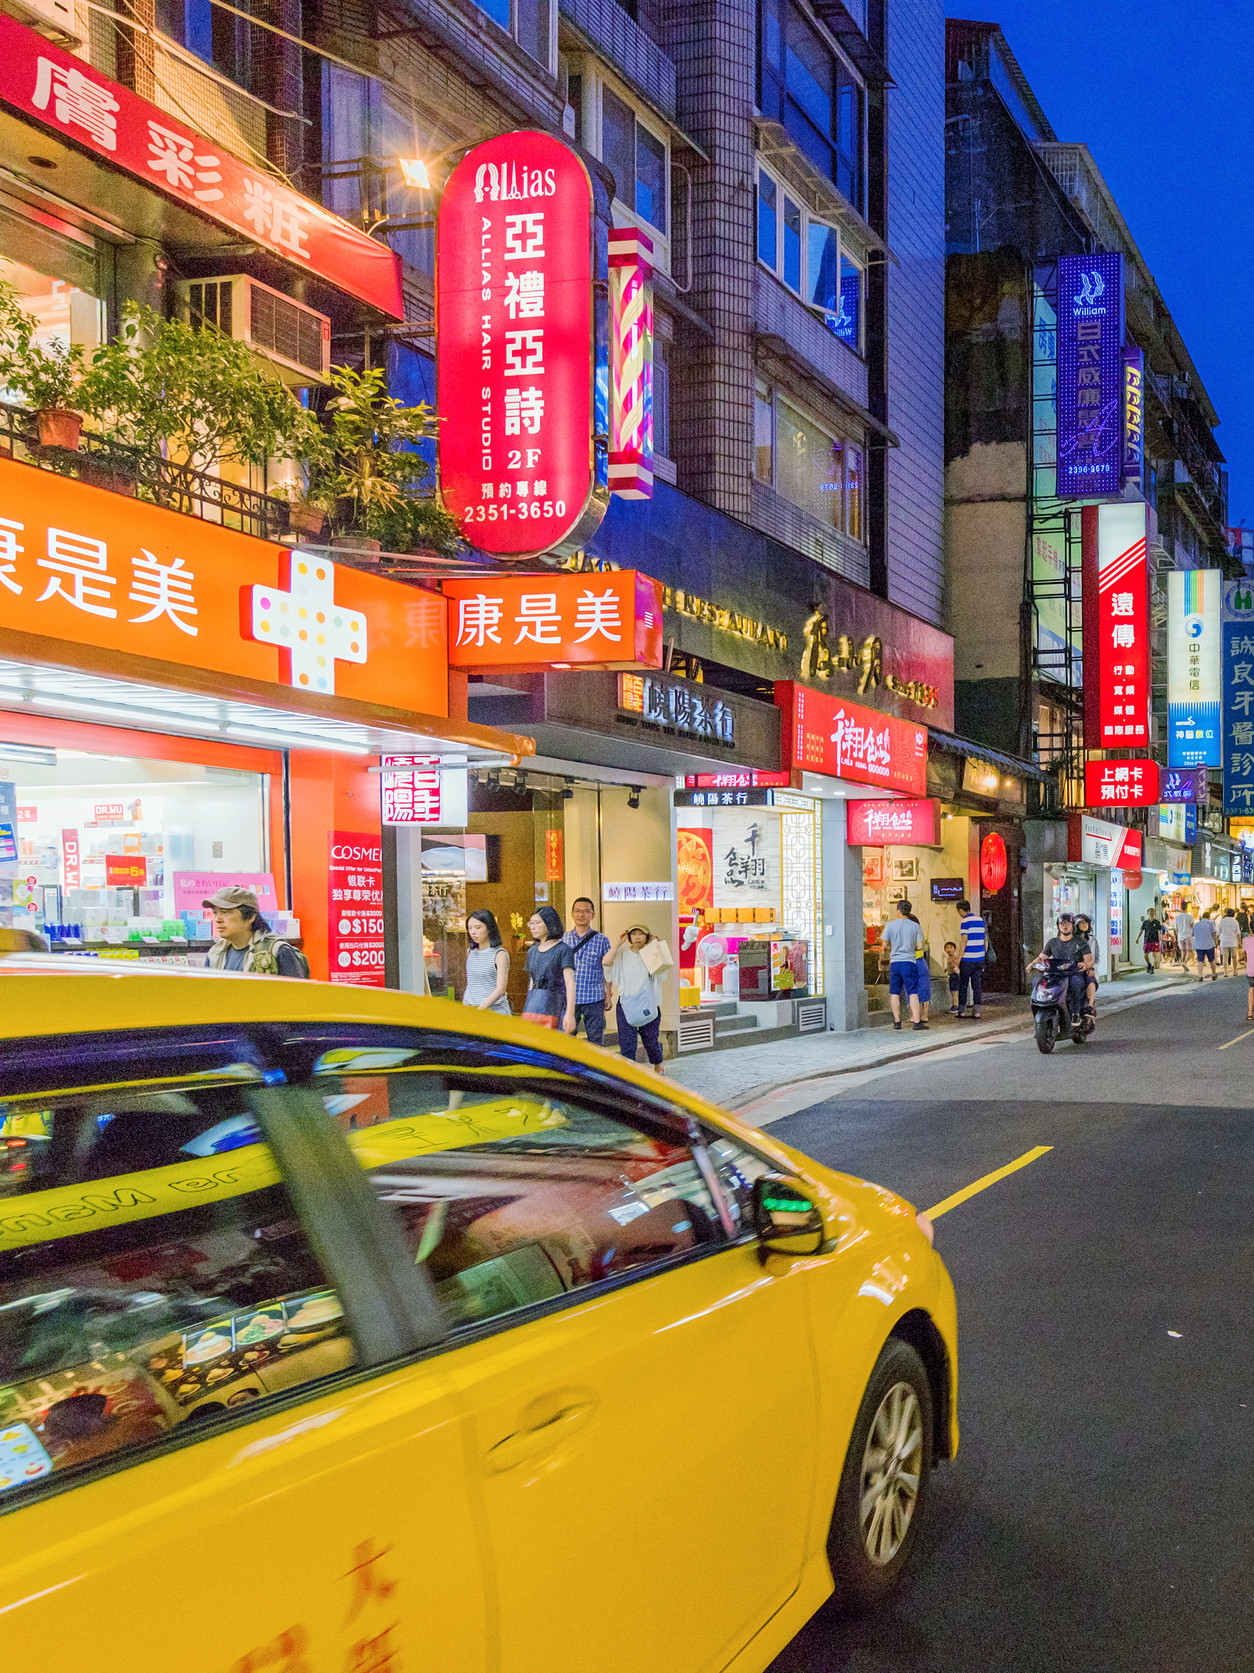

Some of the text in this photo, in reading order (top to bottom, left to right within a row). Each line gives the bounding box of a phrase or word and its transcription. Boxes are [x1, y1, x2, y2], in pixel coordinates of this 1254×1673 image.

[1073, 307, 1106, 317] William
[503, 212, 546, 436] 亞禮亞詩
[481, 217, 492, 471] ALLIAS HAIR STUDIO
[508, 449, 541, 469] 2F
[481, 480, 548, 499] 預約專線
[464, 500, 566, 521] 2351-3650
[455, 588, 622, 648] 康是美
[1111, 592, 1135, 649] 遠傳
[1113, 665, 1135, 676] 行動
[1188, 642, 1201, 691] 中華電信
[1104, 725, 1145, 736] 國際服務
[1100, 767, 1144, 783] 上網卡
[692, 792, 749, 806] 嶢陽茶行
[1100, 784, 1144, 800] 預付卡
[331, 845, 383, 862] COSME
[347, 875, 375, 888] 银联卡
[332, 889, 383, 902] 独享尊荣优
[607, 885, 669, 901] 嶢陽茶行
[352, 919, 385, 934] $150
[352, 950, 385, 966] $200
